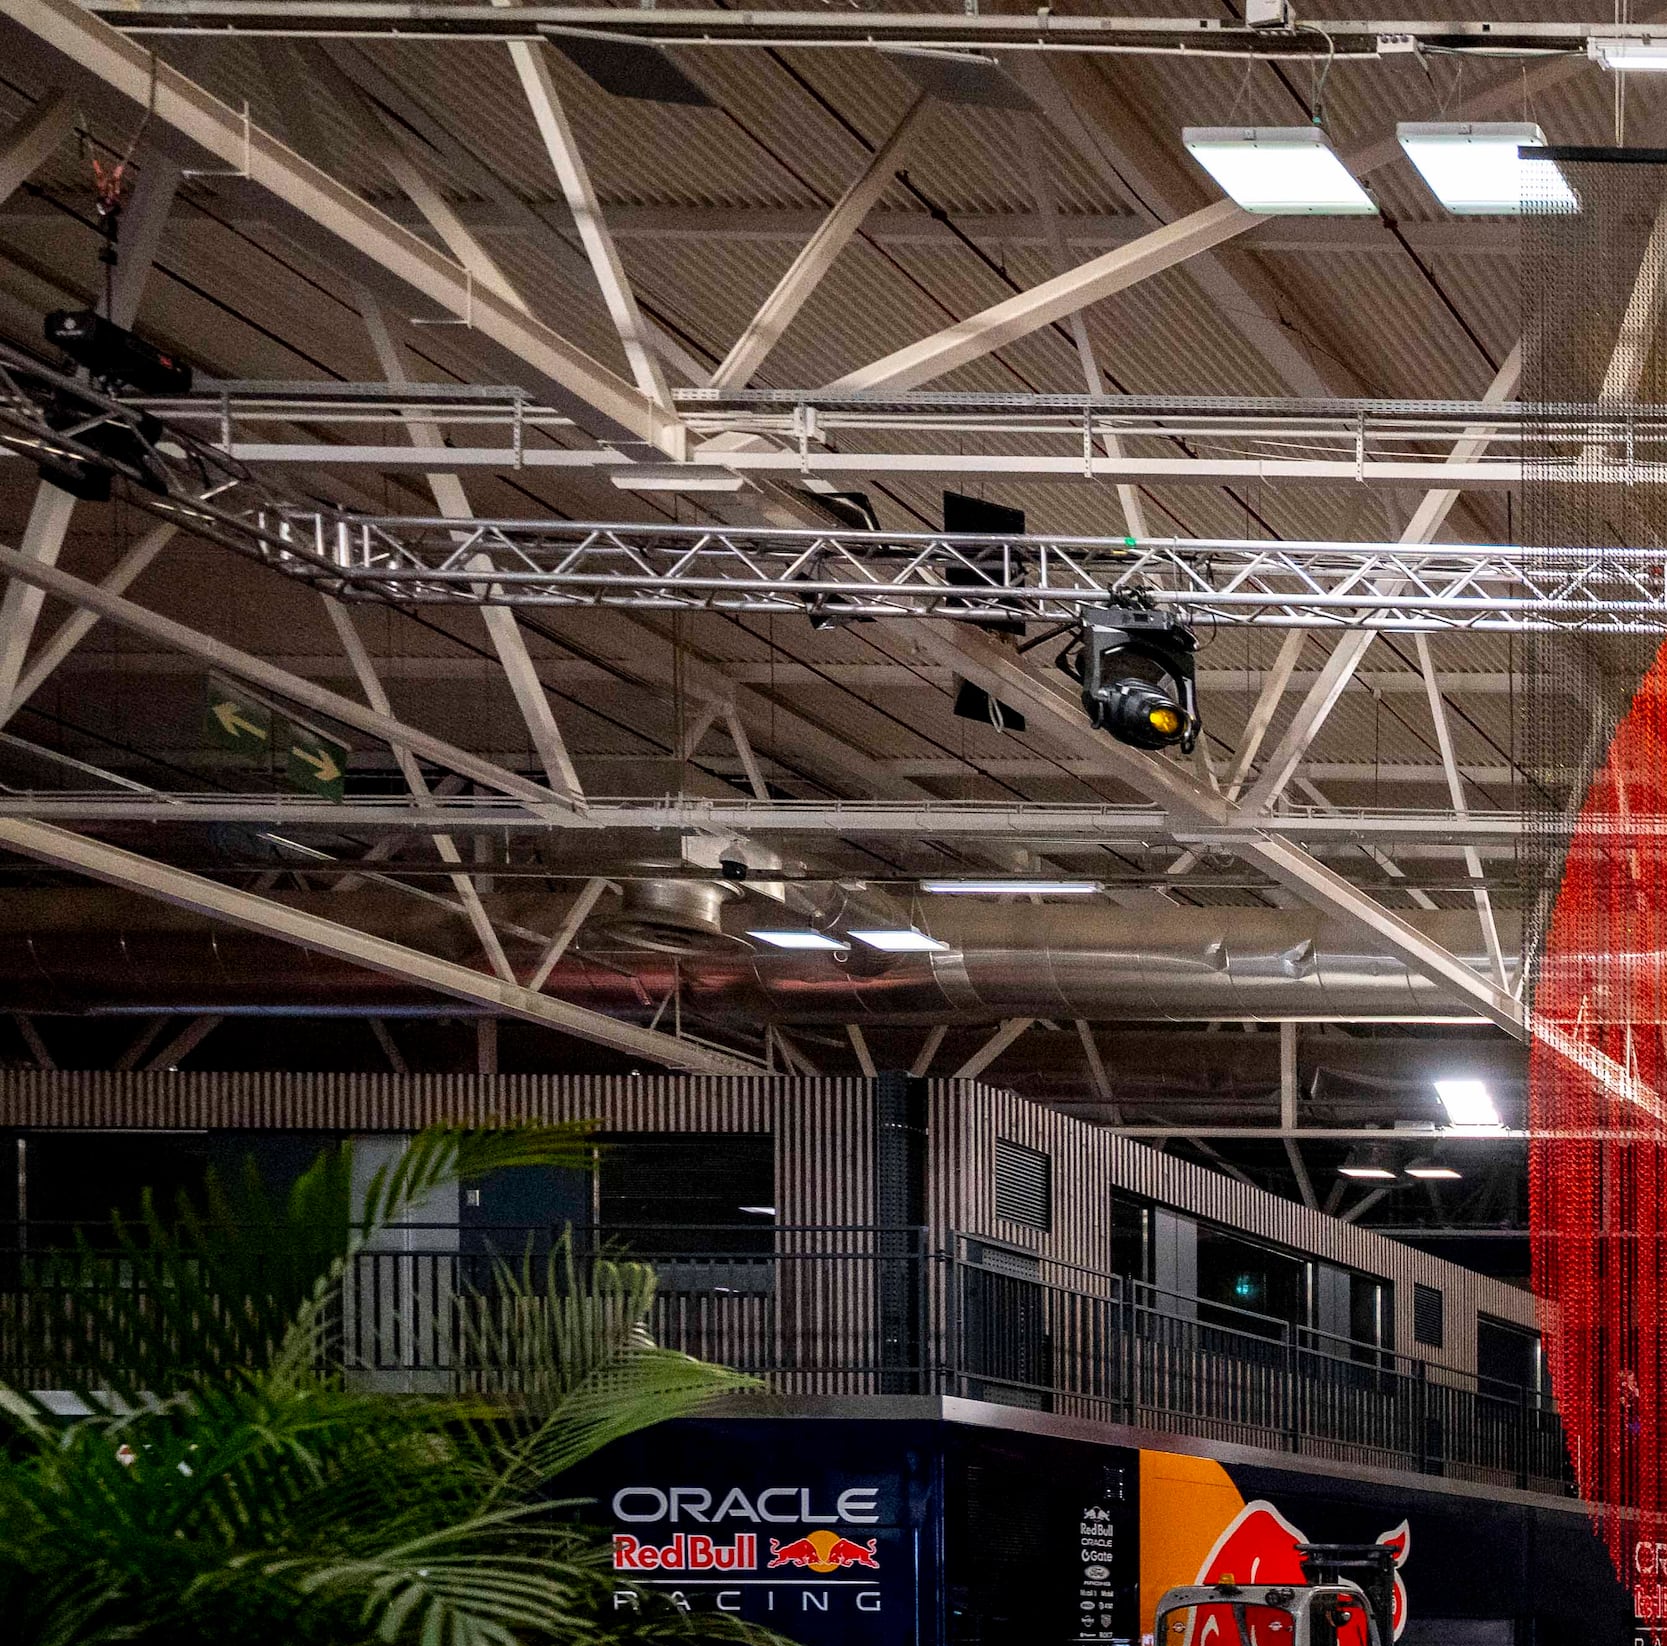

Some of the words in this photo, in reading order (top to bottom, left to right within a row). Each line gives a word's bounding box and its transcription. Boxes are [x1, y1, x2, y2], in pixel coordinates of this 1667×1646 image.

[612, 1487, 879, 1523] ORACLE
[1081, 1522, 1097, 1535] Red
[1098, 1524, 1113, 1536] Bull
[613, 1533, 685, 1569] Red
[688, 1533, 757, 1570] Bull
[1081, 1538, 1112, 1547] ORACLE
[613, 1591, 881, 1611] RACING
